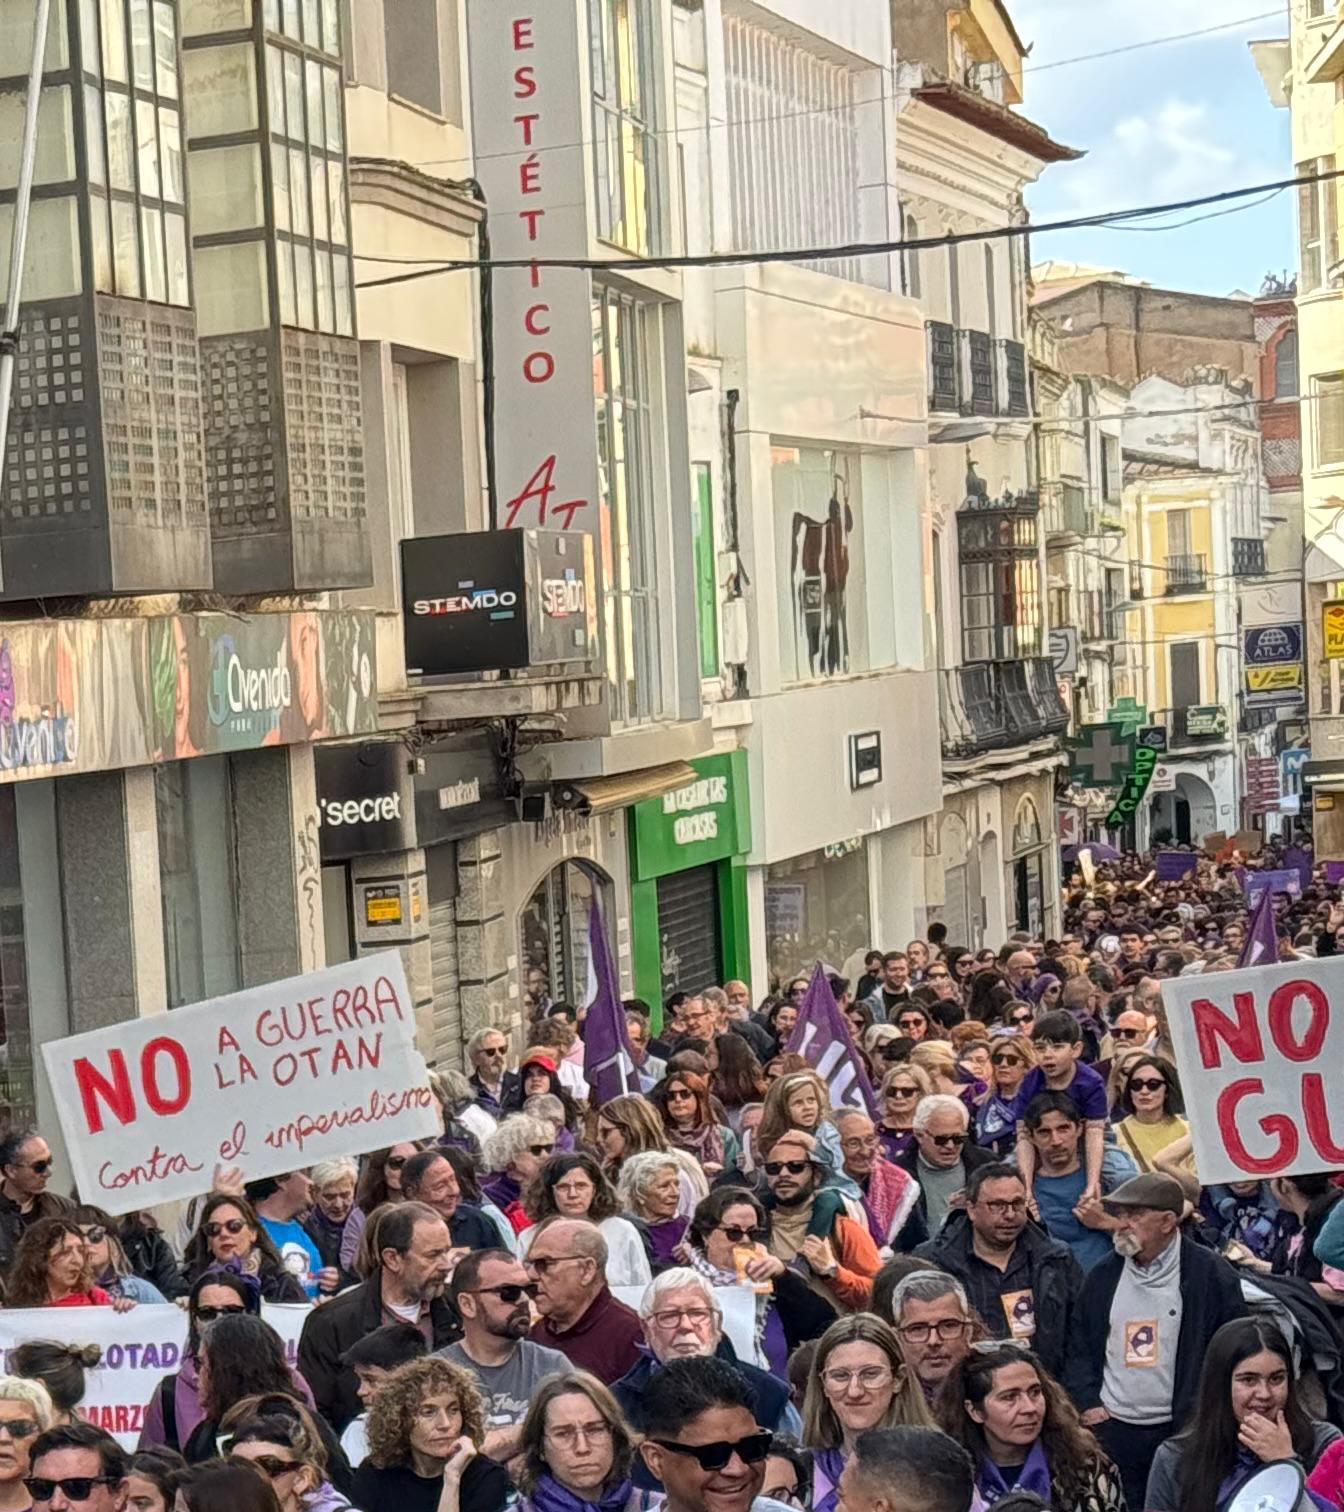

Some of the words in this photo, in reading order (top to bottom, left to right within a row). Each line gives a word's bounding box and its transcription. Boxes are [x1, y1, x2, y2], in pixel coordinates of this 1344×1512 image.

[414, 592, 517, 615] STEMDO
[1253, 643, 1293, 659] ATLAS
[1191, 979, 1331, 1069] NO
[73, 1035, 192, 1135] NO
[218, 1025, 241, 1056] A
[255, 975, 405, 1048] GUERRA
[214, 1052, 258, 1089] LA
[272, 1031, 384, 1087] OTAN
[220, 1121, 250, 1161] el
[79, 1404, 145, 1434] MARZ
